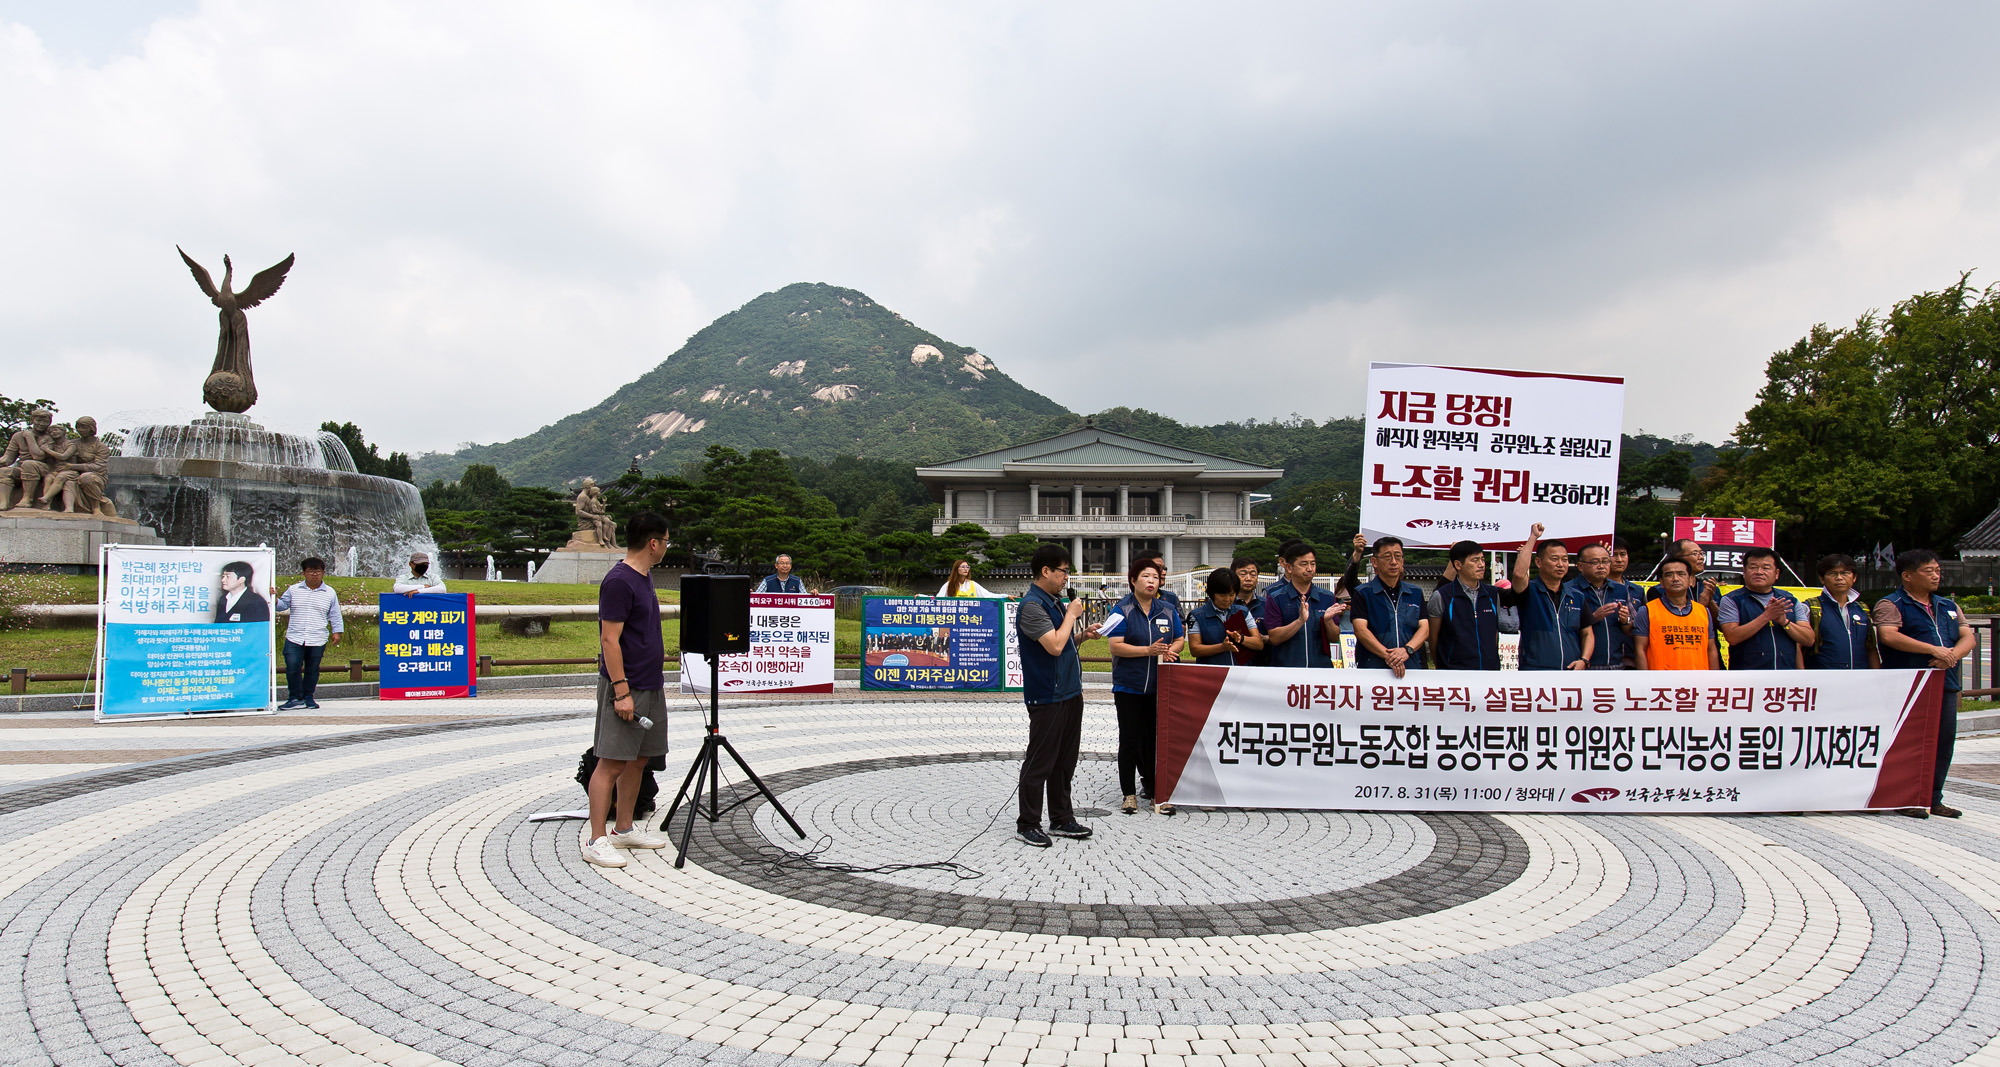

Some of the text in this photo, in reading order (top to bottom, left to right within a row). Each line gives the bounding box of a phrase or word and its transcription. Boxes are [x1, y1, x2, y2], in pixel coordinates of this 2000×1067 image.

[1377, 390, 1512, 428] 지금 당장!
[1376, 427, 1612, 459] 해직자 원직복직 공무원노조 설립신고
[1370, 463, 1610, 506] 노조할 권리 보장하라!
[1435, 519, 1501, 532] 전국공무원노동조합
[122, 561, 203, 574] 박근혜 정치탄압
[122, 574, 178, 586] 최대피해자
[120, 586, 210, 600] 이석기의원을
[120, 600, 210, 614] 석방해주세요
[383, 610, 465, 624] 부당 계약 파기
[757, 615, 802, 628] 대통령은
[882, 614, 983, 626] 문재인 대통령의 약속!
[410, 629, 444, 640] 에 대한
[750, 630, 794, 643] 활동으로
[796, 630, 830, 643] 해직된
[384, 643, 464, 657] 책임과 배상을
[752, 646, 774, 658] 복직
[778, 646, 812, 658] 약속을
[398, 661, 452, 673] 요구합니다!
[718, 660, 804, 674] 조속히 이행하라!
[190, 676, 212, 686] 이석기
[874, 668, 989, 683] 이젠 지켜주십시오!!
[1286, 684, 1816, 714] 해직자 원직복직, 설립신고 등 노조할 권리 쟁취!
[1216, 721, 1880, 772] 전국공무원노동조합 농성투쟁 및 위원장 단식농성 돌입 기자회견
[1354, 785, 1394, 800] 2017.
[1463, 787, 1502, 801] 11:00
[1514, 786, 1555, 803] 청와대
[1624, 786, 1741, 804] 전국공무원노동조합
